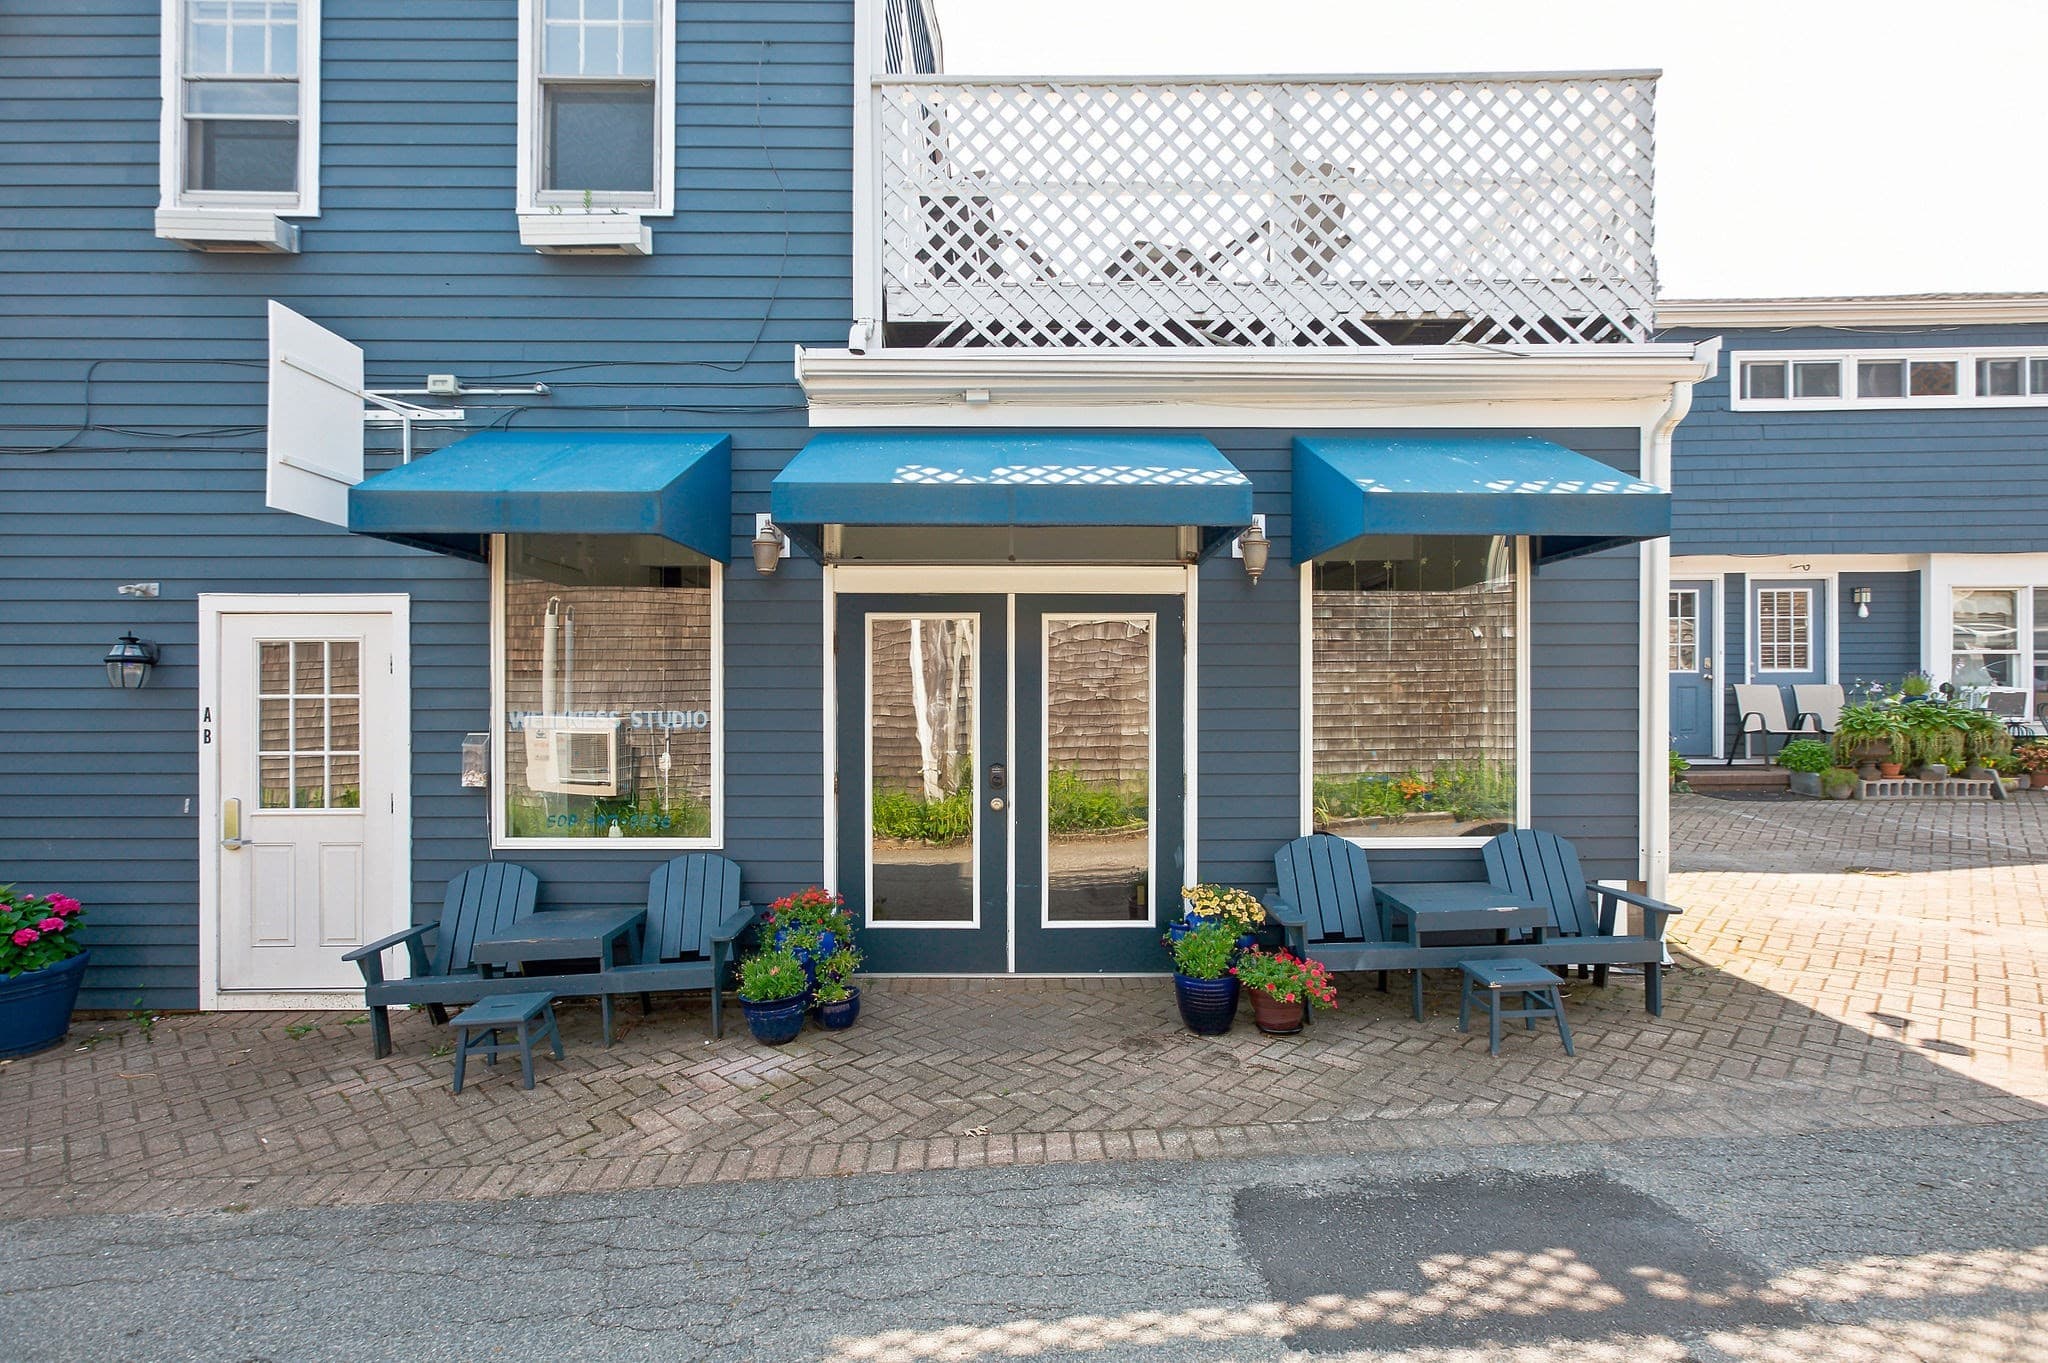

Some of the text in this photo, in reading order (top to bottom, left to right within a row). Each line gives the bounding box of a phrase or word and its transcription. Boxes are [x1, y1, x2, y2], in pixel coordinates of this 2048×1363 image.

[204, 707, 211, 722] A
[630, 710, 708, 730] STUDIO
[204, 729, 211, 744] B
